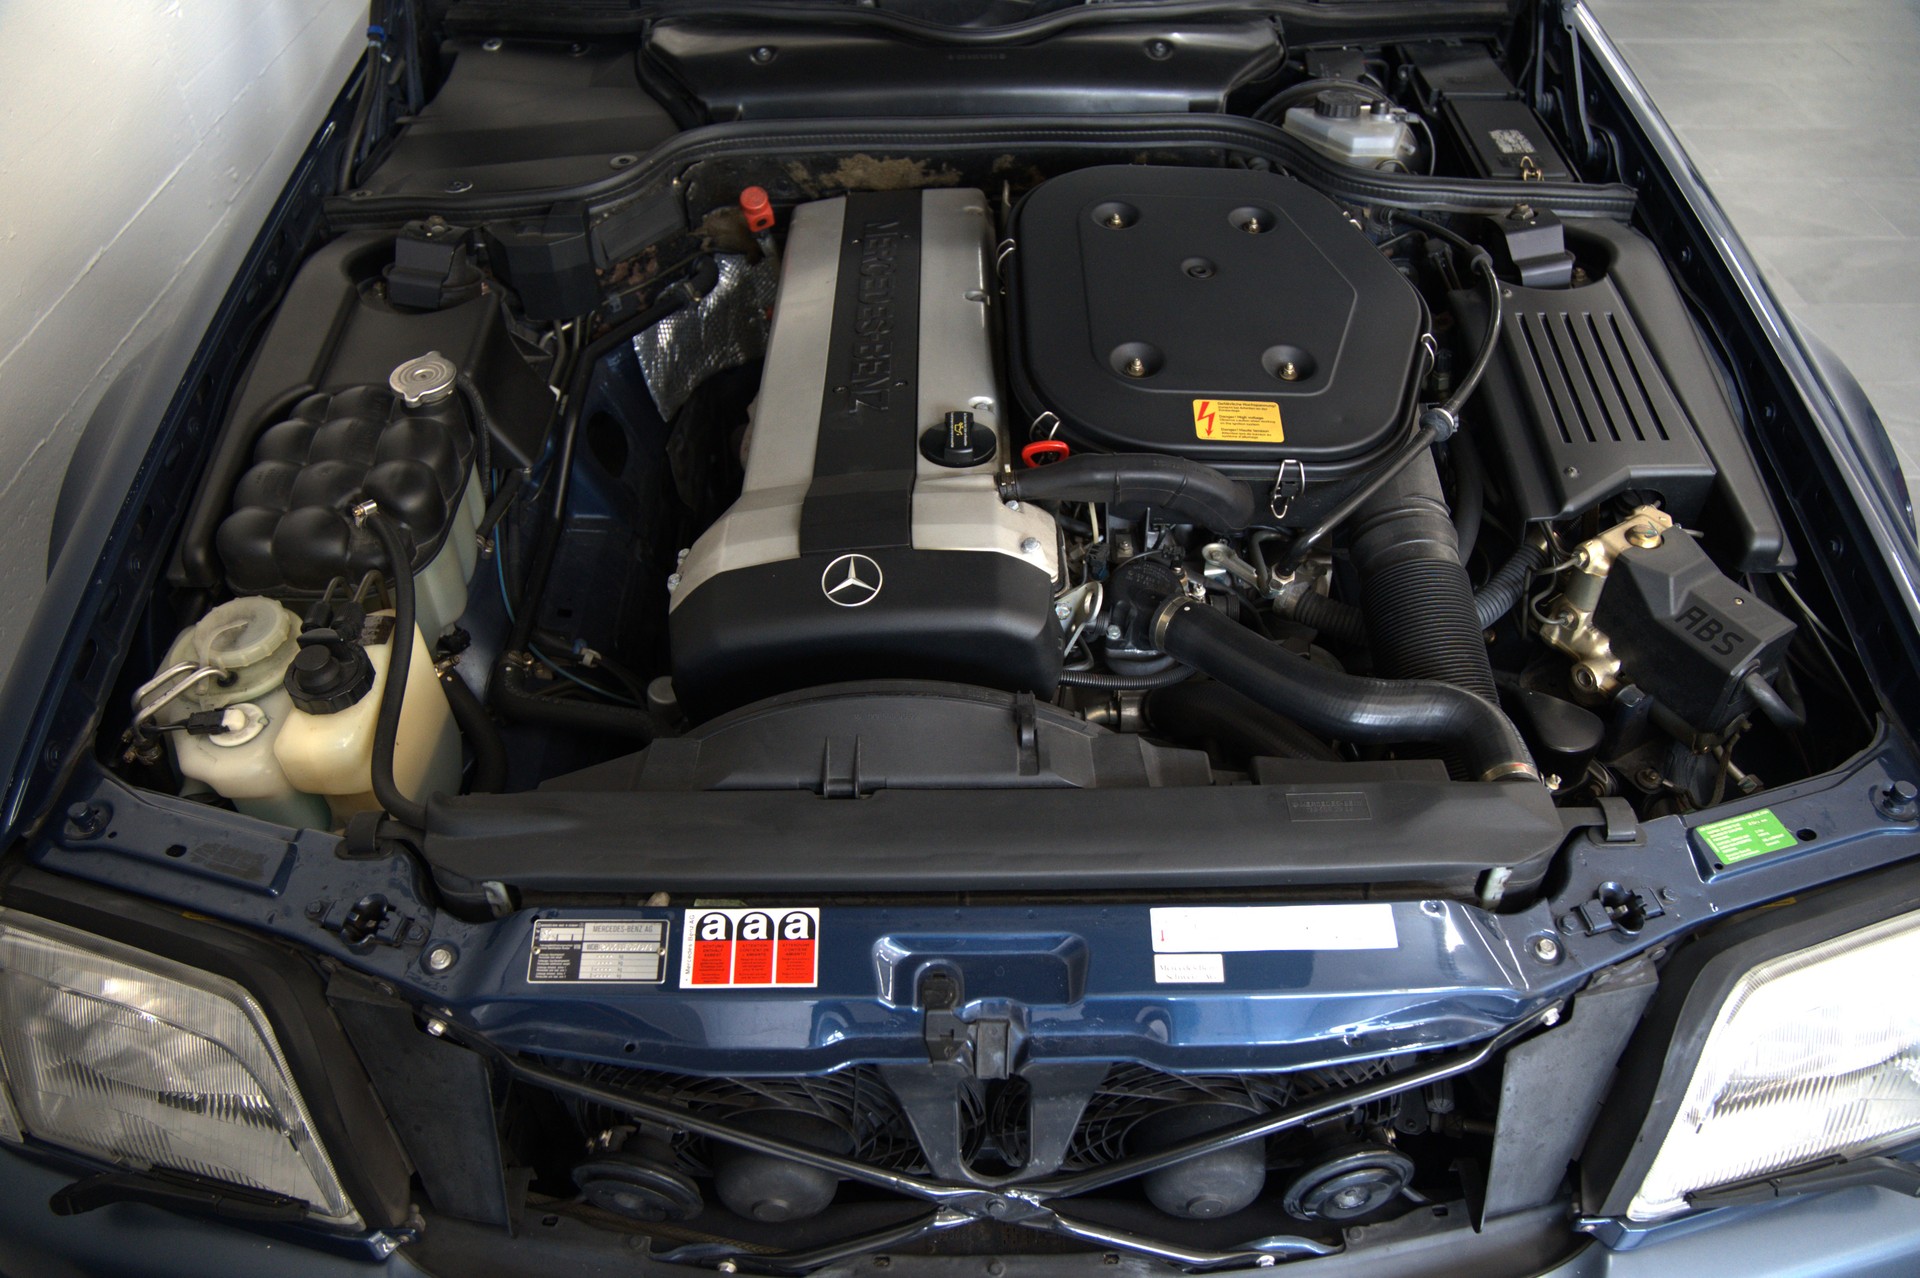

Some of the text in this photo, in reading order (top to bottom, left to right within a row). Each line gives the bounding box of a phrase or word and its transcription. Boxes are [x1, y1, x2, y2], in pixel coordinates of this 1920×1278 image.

[850, 221, 899, 413] MERCEDES-BENZ
[1674, 605, 1745, 655] ABS
[593, 925, 642, 933] MERCEDES-BENZ
[644, 925, 653, 933] AG
